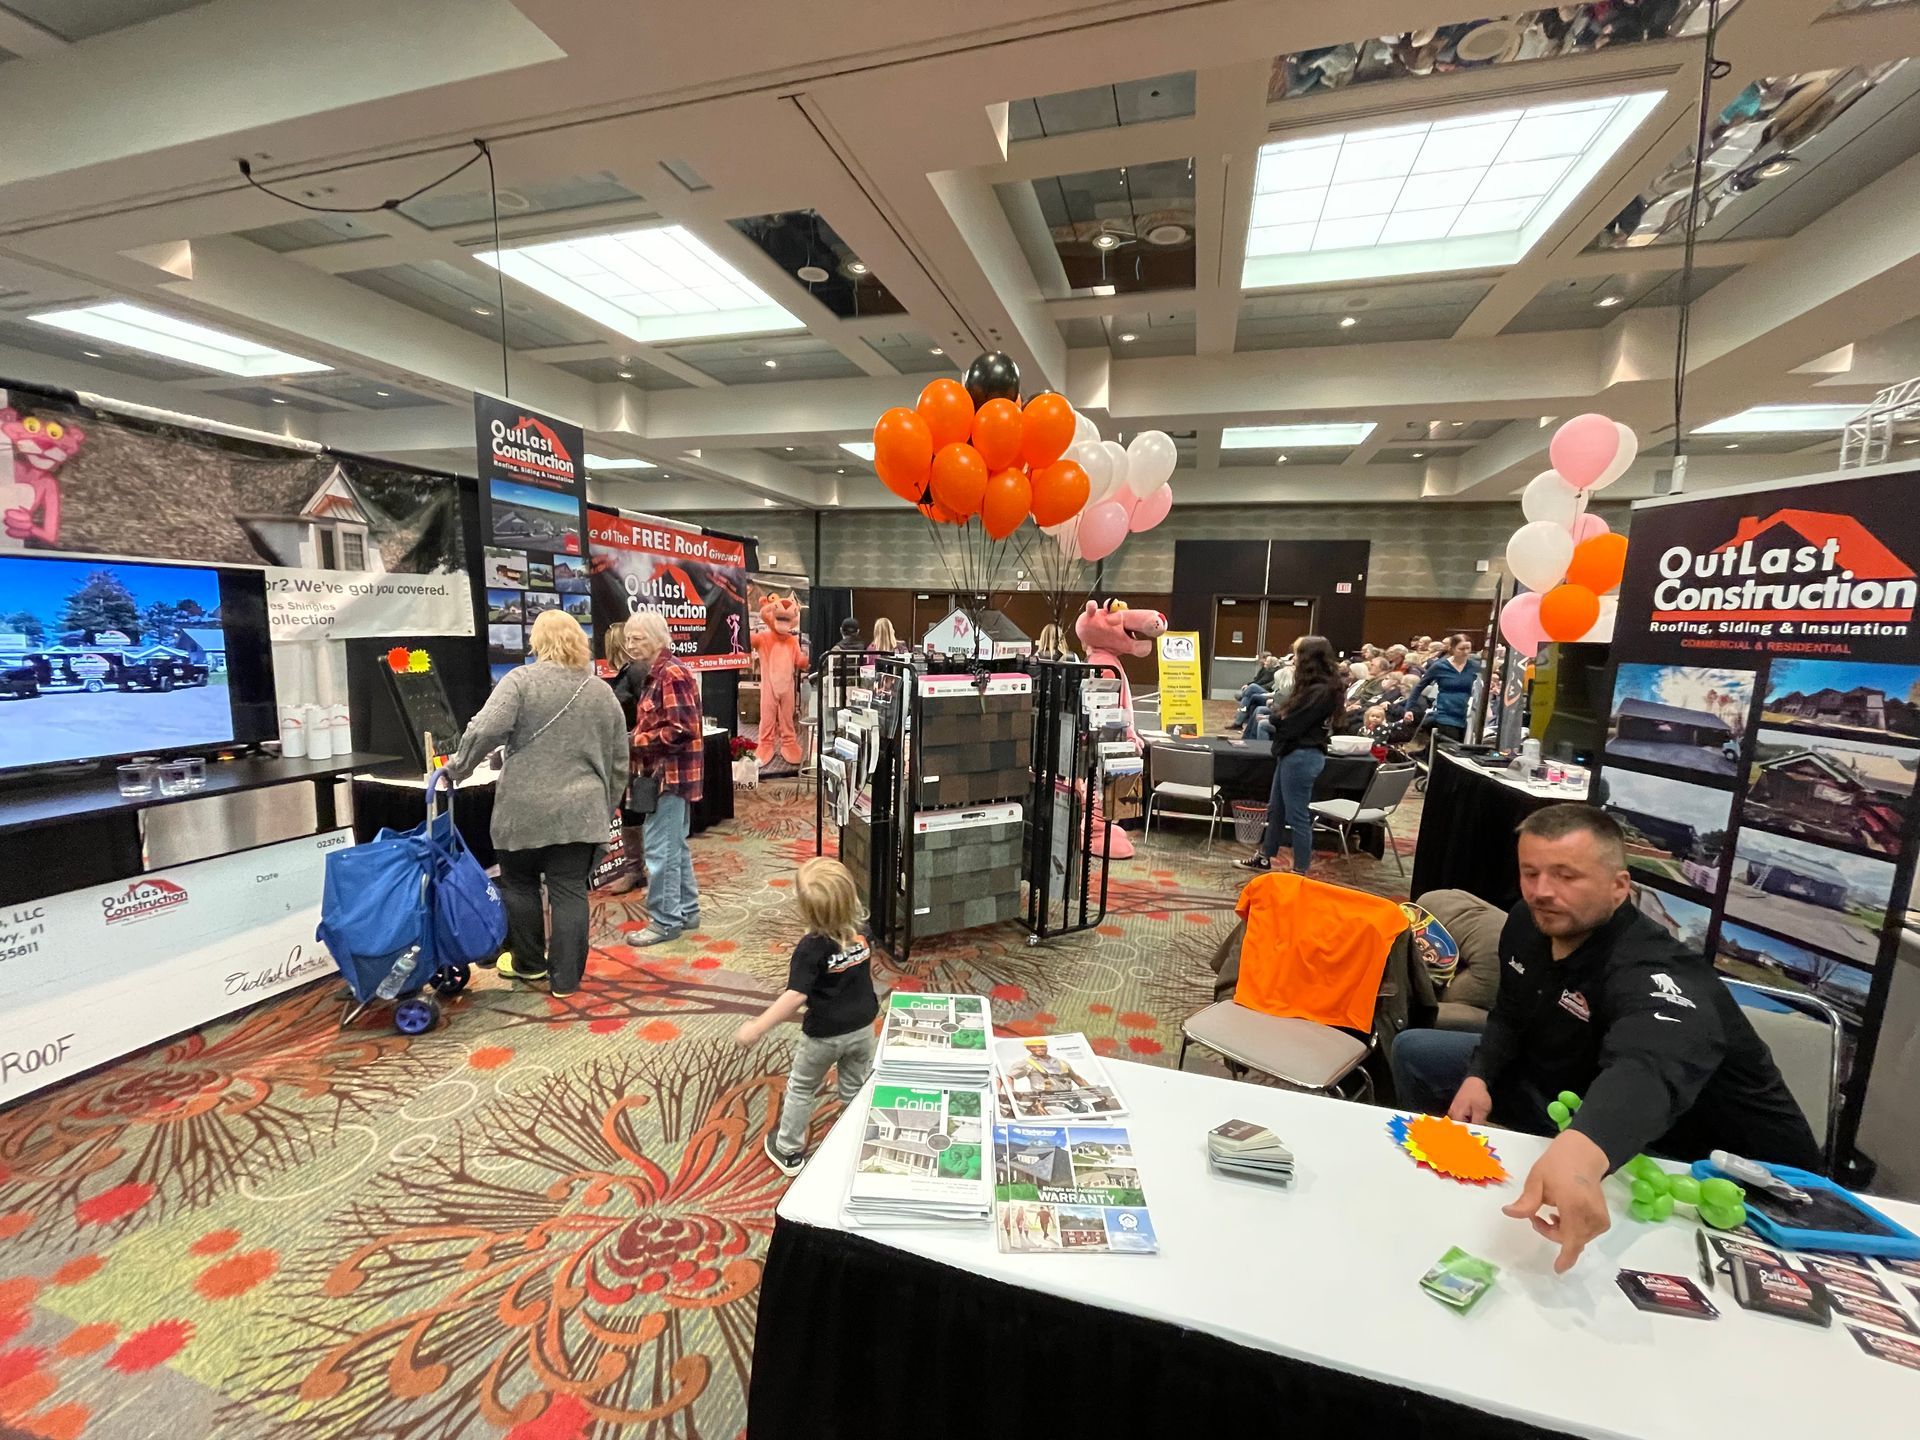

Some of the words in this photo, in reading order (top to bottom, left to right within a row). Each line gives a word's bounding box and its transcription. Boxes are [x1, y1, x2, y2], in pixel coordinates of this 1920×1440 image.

[491, 419, 552, 453] OutLast
[492, 437, 574, 473] Construction
[613, 530, 630, 544] The
[632, 526, 671, 551] FREE
[675, 535, 708, 557] Roof
[1659, 538, 1840, 579] OutLast
[295, 579, 344, 594] We've
[349, 583, 374, 596] got
[376, 584, 394, 597] you
[397, 584, 449, 596] covered.
[624, 574, 686, 599] OutLast
[1654, 570, 1917, 611] Construction
[288, 601, 336, 612] Shingles
[270, 615, 335, 626] ollection
[1650, 621, 1713, 635] Roofing,
[1718, 621, 1773, 636] Siding
[1779, 622, 1794, 634] &
[1801, 622, 1908, 636] Insulation
[1681, 638, 1751, 650] COMMERCIAL
[1767, 641, 1851, 654] RESIDENTIAL
[699, 658, 718, 668] Snow
[718, 656, 750, 667] Removal
[316, 836, 346, 849] 023762
[256, 872, 279, 883] Date
[102, 887, 164, 908] OutLast
[103, 890, 188, 919] Construction
[13, 907, 45, 923] LLC
[1, 1032, 76, 1085] ROOF
[894, 1096, 942, 1111] Color
[1037, 1191, 1116, 1205] WARRANTY
